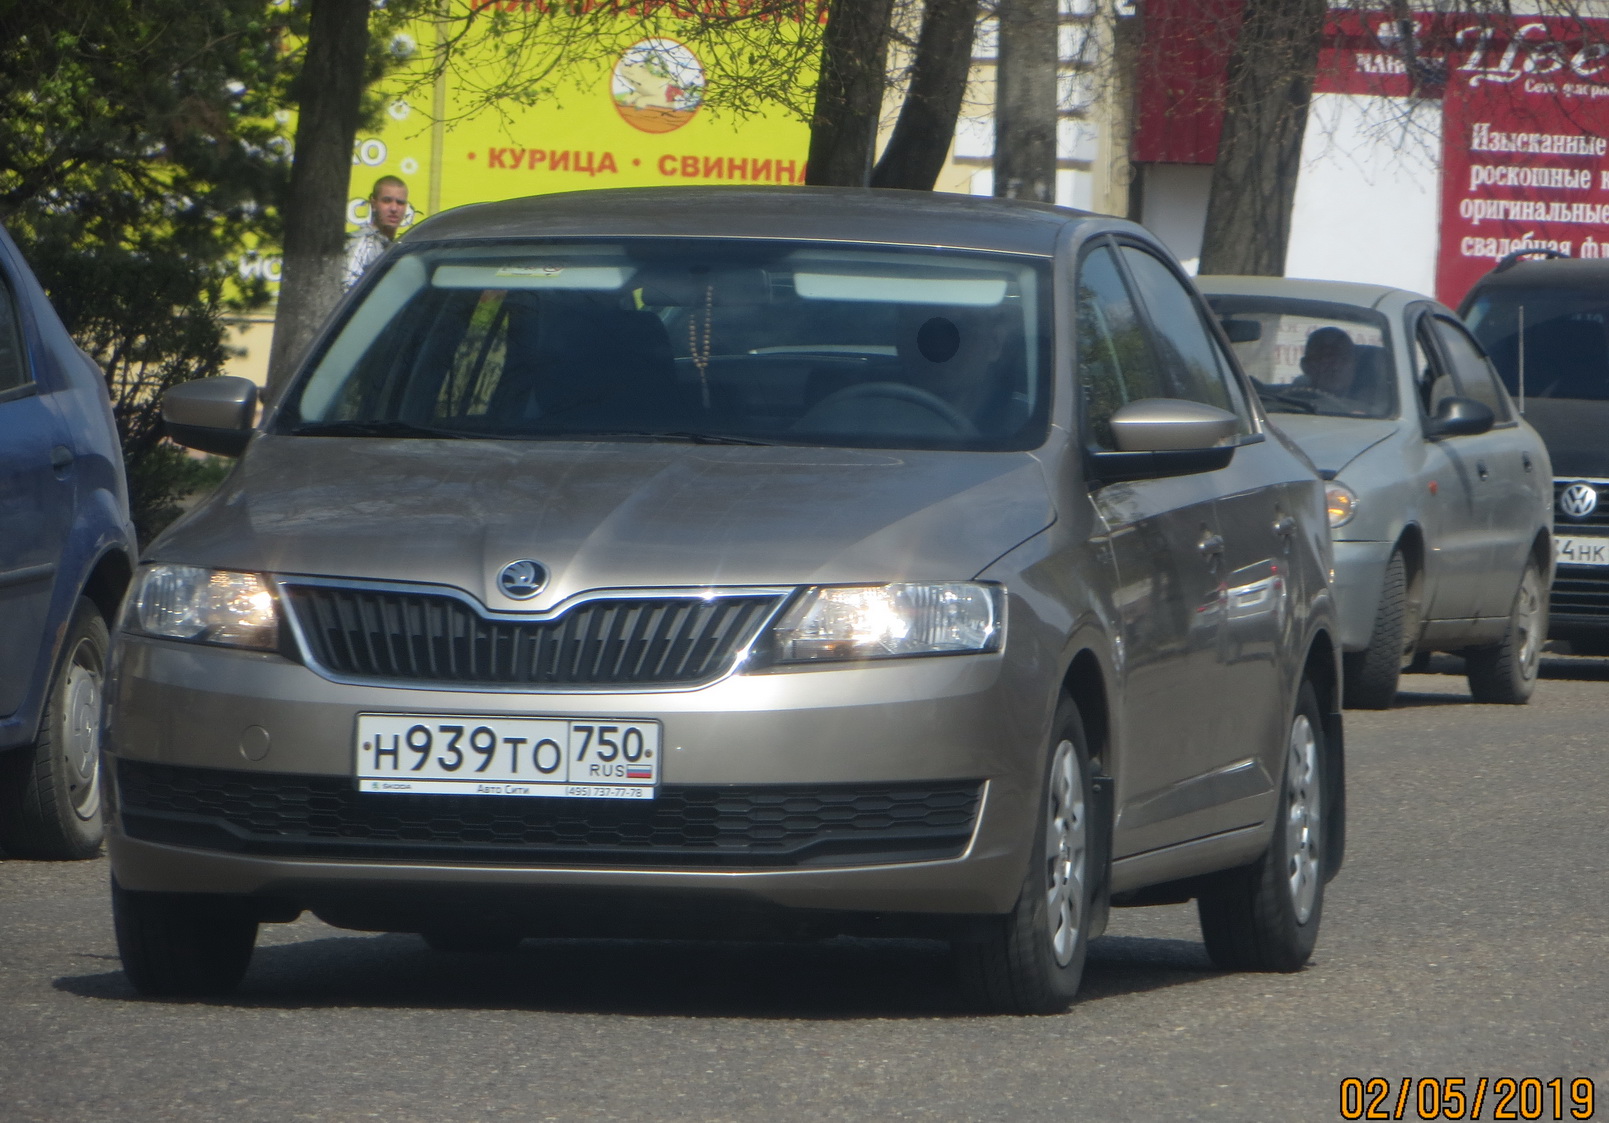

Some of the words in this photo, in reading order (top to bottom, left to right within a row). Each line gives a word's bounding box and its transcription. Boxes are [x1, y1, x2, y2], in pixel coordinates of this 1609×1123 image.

[1470, 122, 1607, 156] Изысканные
[487, 148, 618, 177] КУРИЦА
[1469, 164, 1592, 192] роскошные
[1460, 198, 1609, 226] оригинальные
[1555, 539, 1605, 562] 4НК
[374, 724, 562, 774] Н939ТО
[572, 726, 644, 762] 750
[589, 764, 626, 778] RUS
[477, 784, 502, 794] Авто
[504, 785, 531, 795] Сити
[565, 786, 592, 797] (495)
[594, 787, 643, 798] 737-77-78
